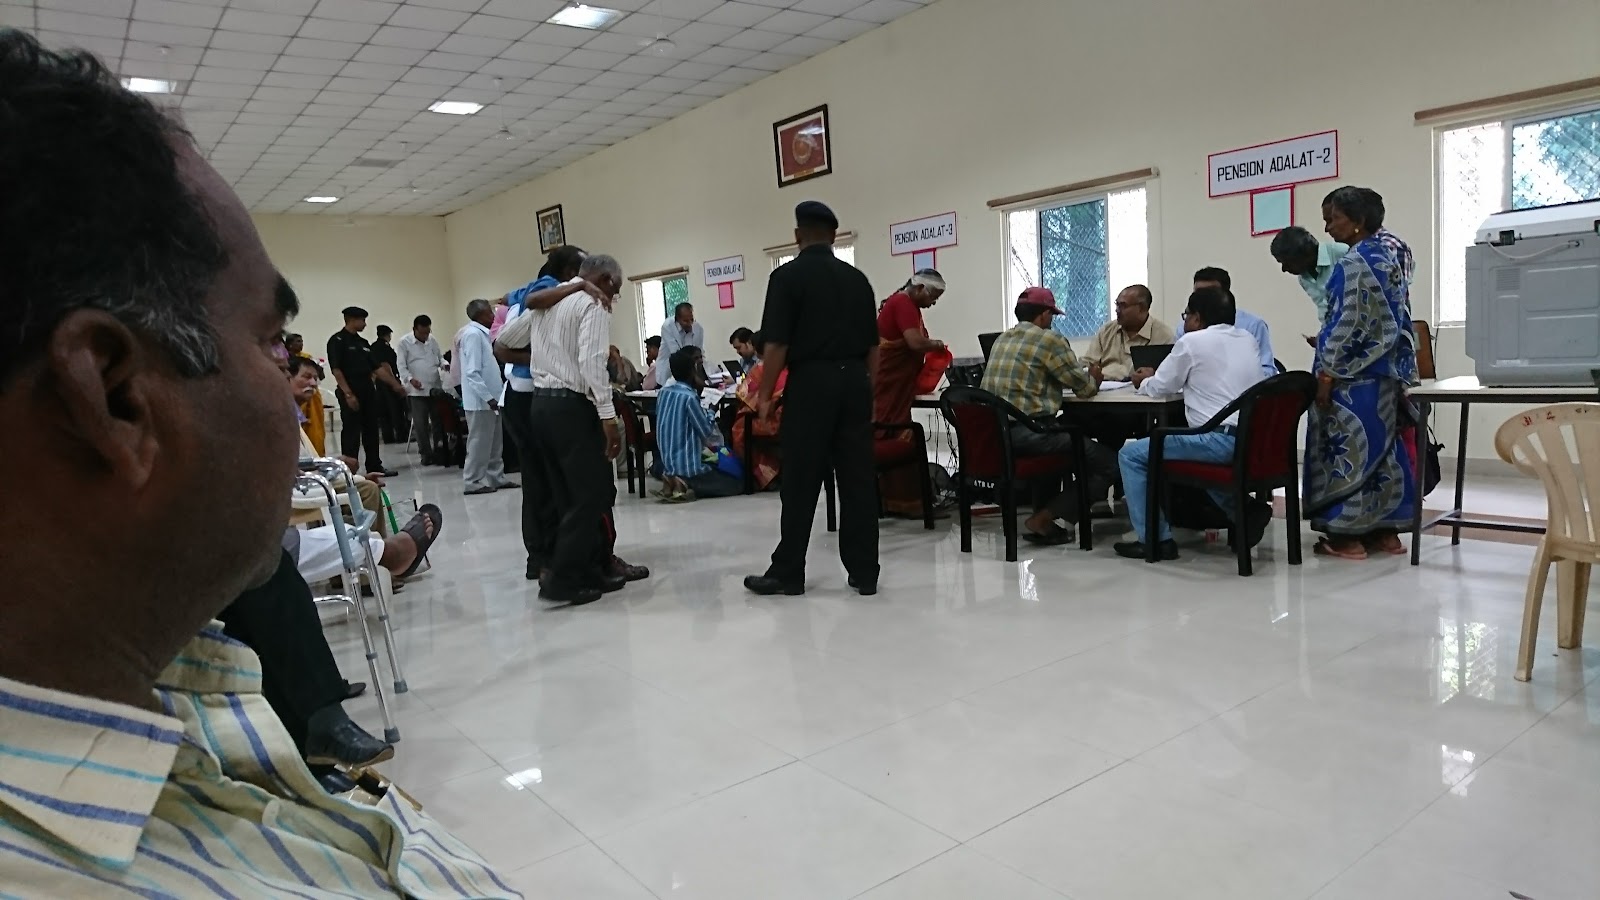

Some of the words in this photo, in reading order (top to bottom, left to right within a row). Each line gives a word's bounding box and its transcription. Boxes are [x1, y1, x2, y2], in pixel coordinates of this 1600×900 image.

[1217, 160, 1264, 182] PENSION
[1269, 147, 1331, 171] ADALAT-2
[894, 230, 918, 245] PENSION
[920, 223, 953, 241] ADALAT-3
